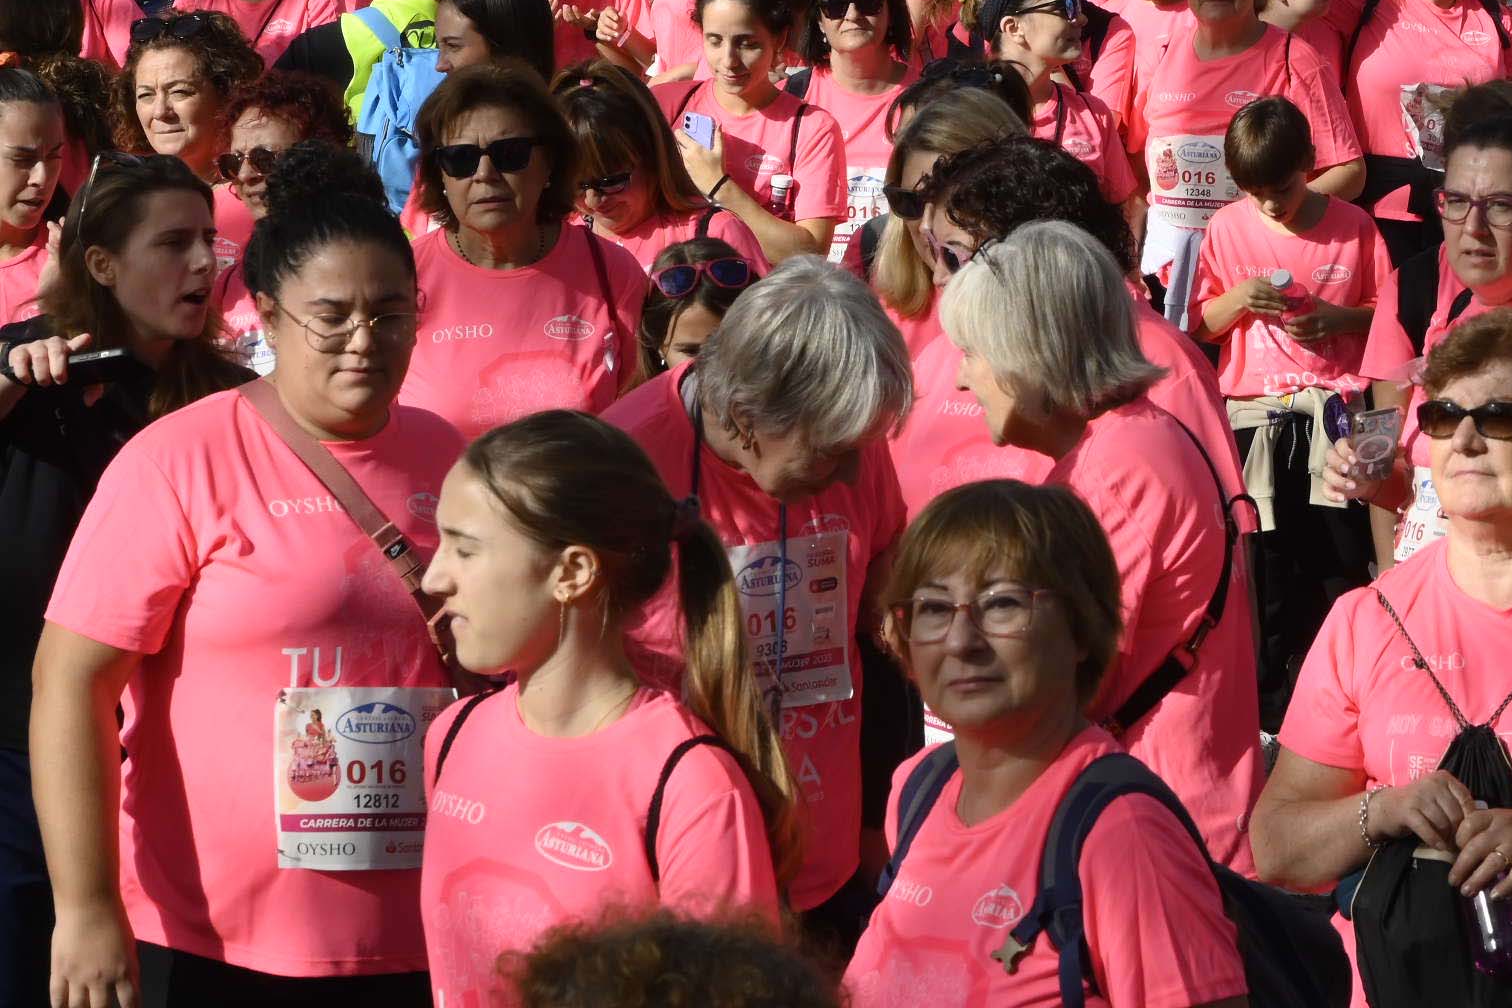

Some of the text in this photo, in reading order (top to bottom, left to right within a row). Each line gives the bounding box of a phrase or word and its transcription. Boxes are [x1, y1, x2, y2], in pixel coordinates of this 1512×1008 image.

[1181, 170, 1216, 185] 016
[1185, 187, 1211, 198] 12348
[432, 323, 493, 343] OYSHO
[1404, 520, 1426, 541] 016
[807, 557, 836, 569] SUMA
[746, 607, 797, 637] 016
[281, 646, 343, 688] TU
[343, 716, 411, 734] ASTURIANA
[346, 759, 407, 785] 016
[353, 793, 400, 809] 12812
[431, 790, 485, 825] OYSHO
[300, 818, 356, 829] CARRERA
[358, 818, 373, 828] DE
[374, 818, 387, 828] LA
[297, 842, 356, 857] OYSHO
[543, 831, 605, 867] ASTURIANA
